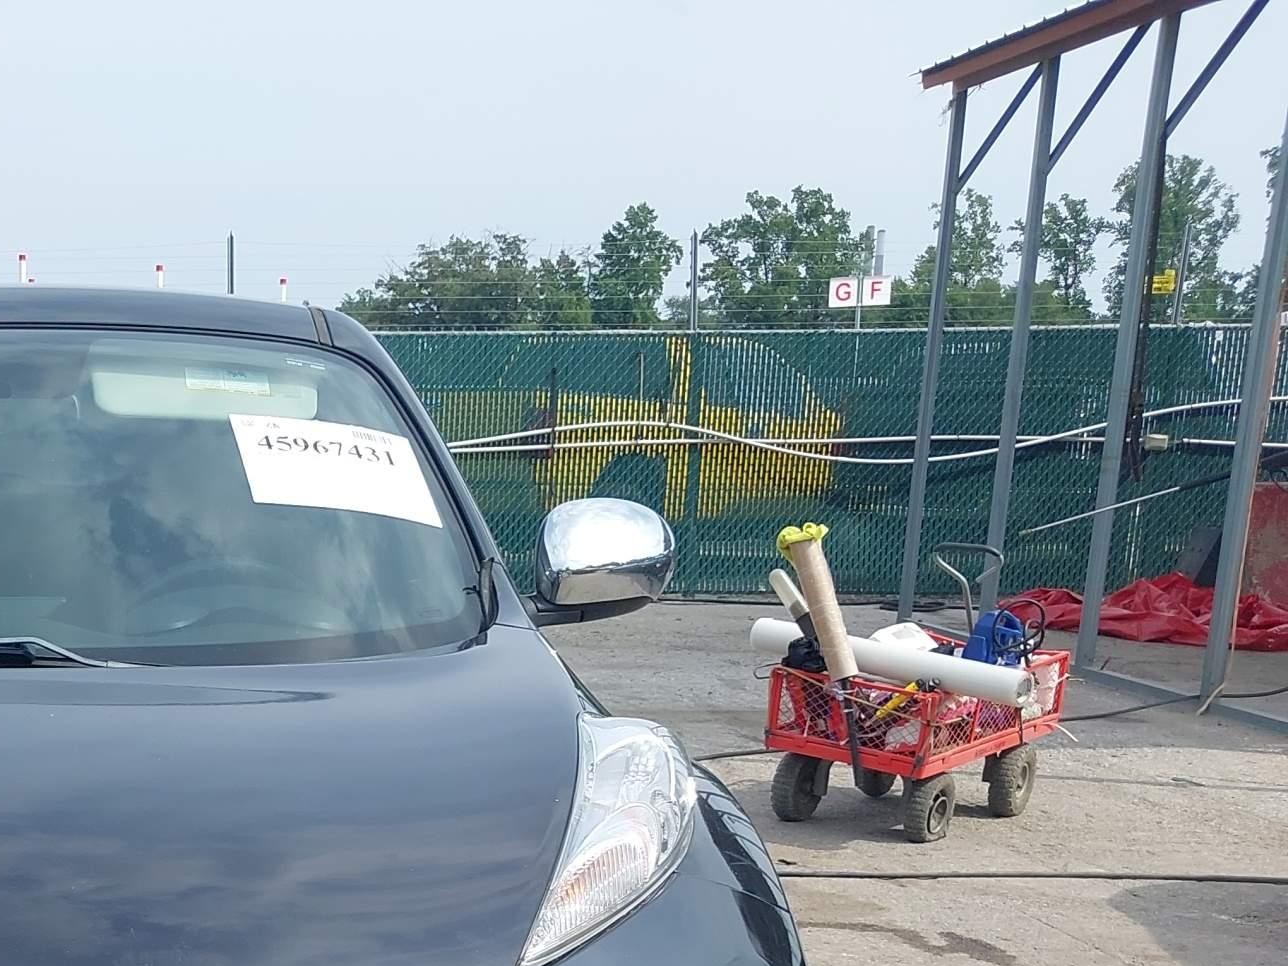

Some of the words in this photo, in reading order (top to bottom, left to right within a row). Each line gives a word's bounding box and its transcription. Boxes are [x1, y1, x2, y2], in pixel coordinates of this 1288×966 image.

[835, 282, 851, 301] G
[870, 280, 883, 300] F
[257, 434, 395, 466] 45967431
